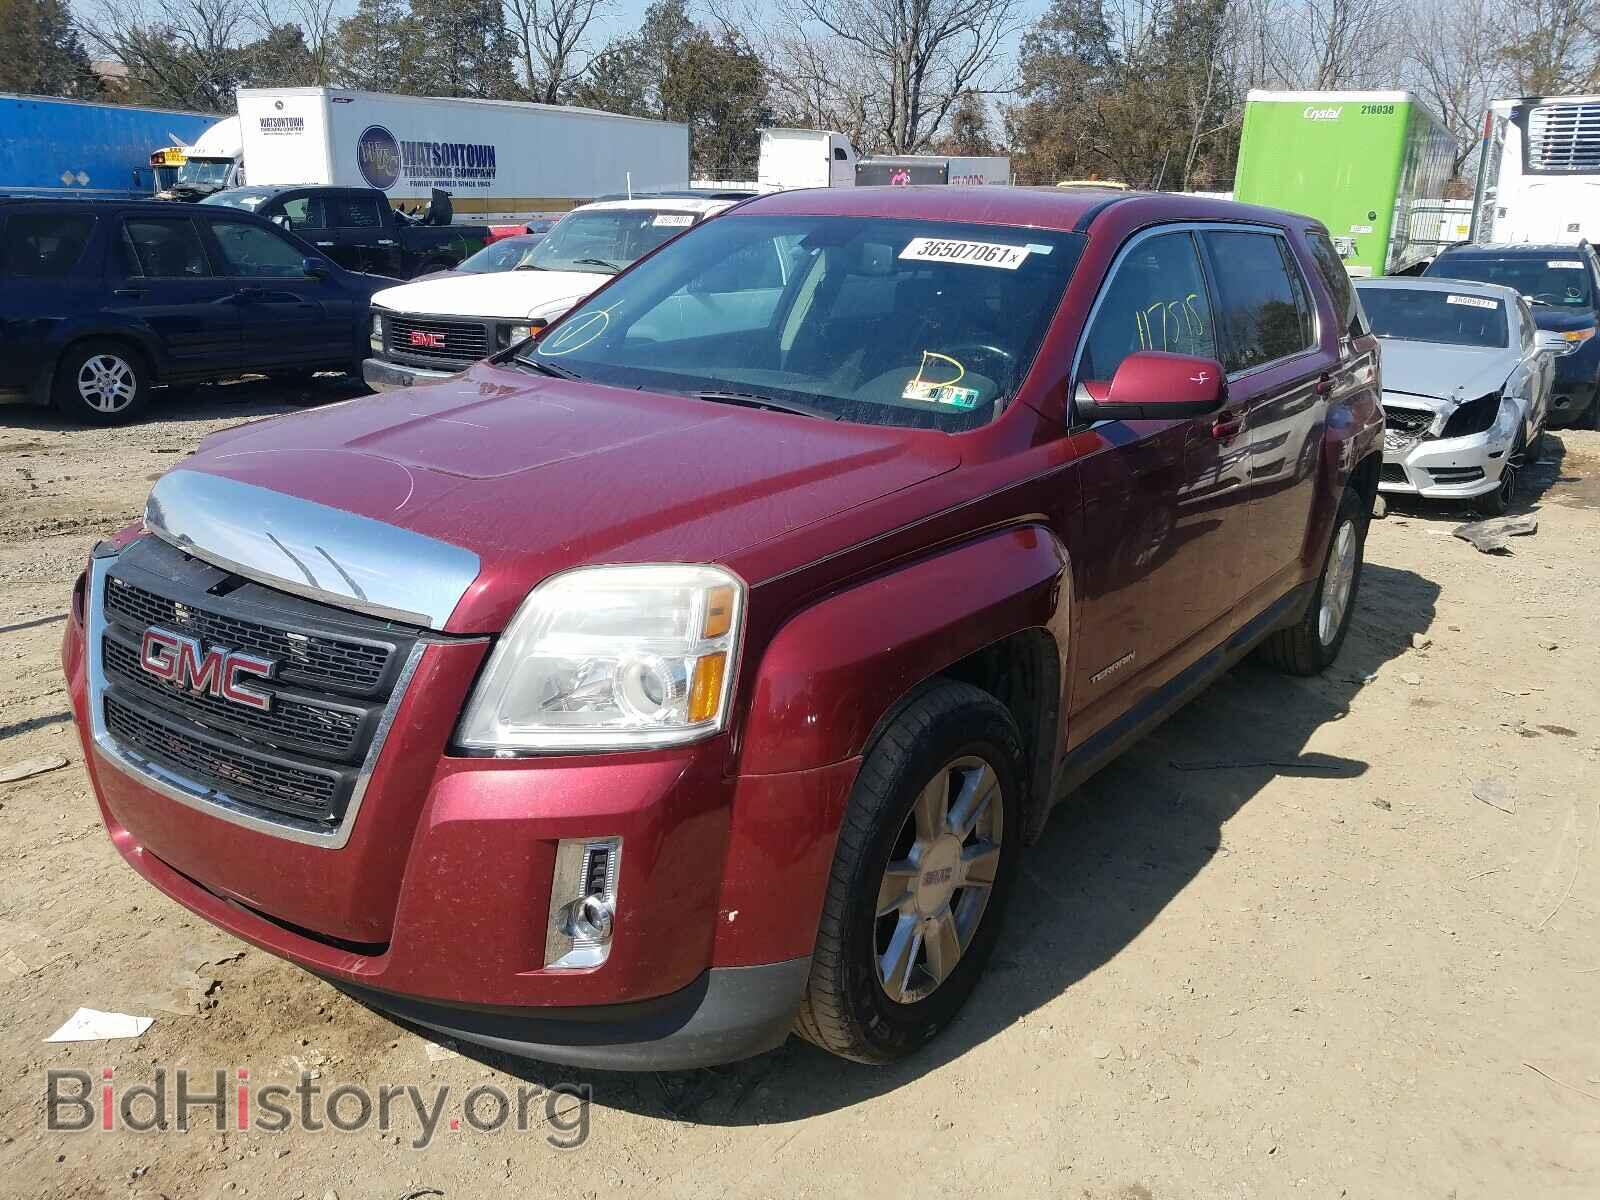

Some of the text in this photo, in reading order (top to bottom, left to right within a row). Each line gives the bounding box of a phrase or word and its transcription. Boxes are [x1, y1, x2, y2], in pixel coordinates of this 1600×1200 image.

[1304, 106, 1343, 121] Crystal
[400, 141, 496, 168] WATSONTOWN
[403, 166, 496, 179] TRUCKING COMPANY
[410, 180, 433, 188] FAMILY
[434, 180, 457, 188] OWNED
[458, 180, 476, 188] SINCE
[409, 330, 446, 348] GMC
[141, 626, 272, 711] GMC
[1088, 650, 1136, 684] TERRAIN
